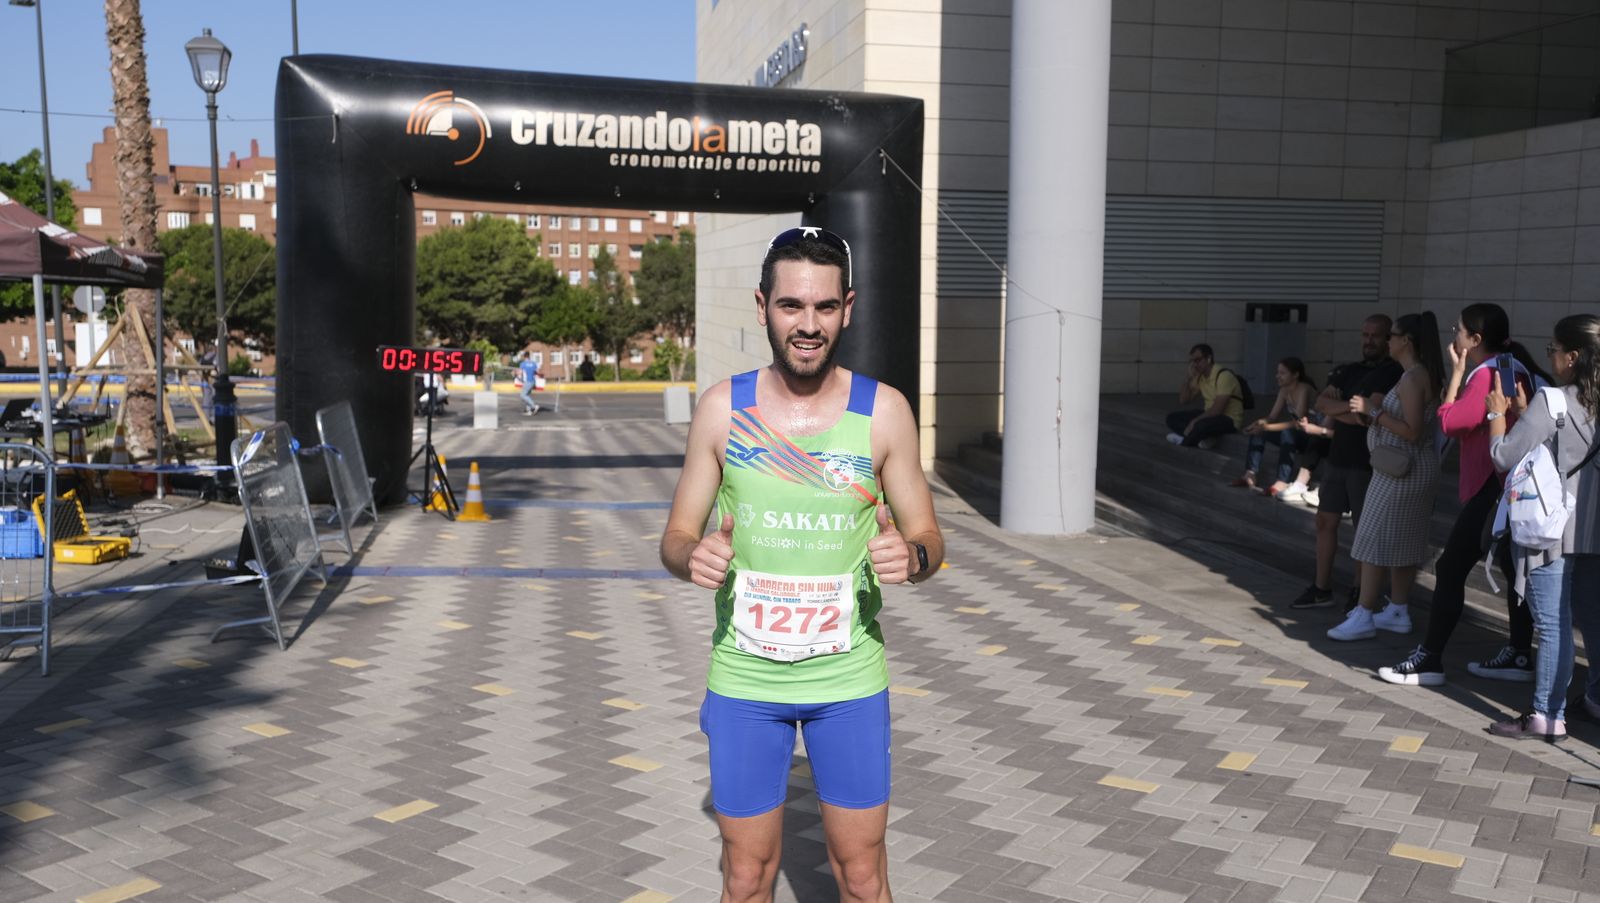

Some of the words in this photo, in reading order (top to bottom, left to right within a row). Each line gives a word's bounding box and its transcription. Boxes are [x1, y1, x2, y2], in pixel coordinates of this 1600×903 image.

[610, 152, 732, 170] cronometraje
[736, 158, 821, 174] deportivo
[383, 348, 479, 373] 00:15:51
[762, 511, 856, 531] SAKATA
[805, 538, 814, 550] in
[817, 539, 843, 550] Seed
[748, 603, 841, 634] 1272
